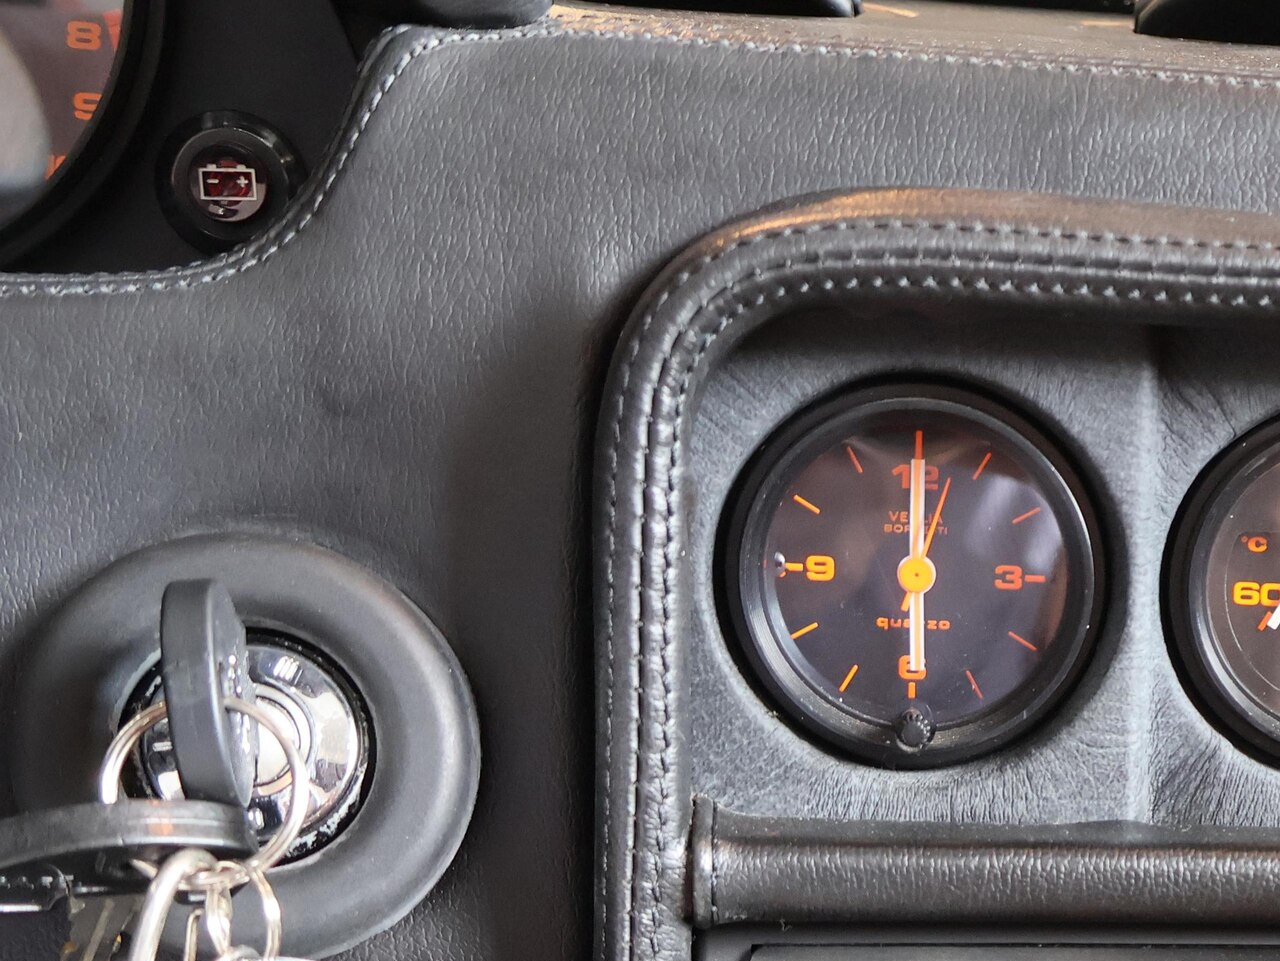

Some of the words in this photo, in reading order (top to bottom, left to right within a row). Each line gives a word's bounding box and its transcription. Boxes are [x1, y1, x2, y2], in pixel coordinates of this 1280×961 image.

[66, 20, 101, 51] 8
[805, 555, 835, 582] 9
[994, 565, 1023, 591] 3
[876, 617, 951, 631] quazo
